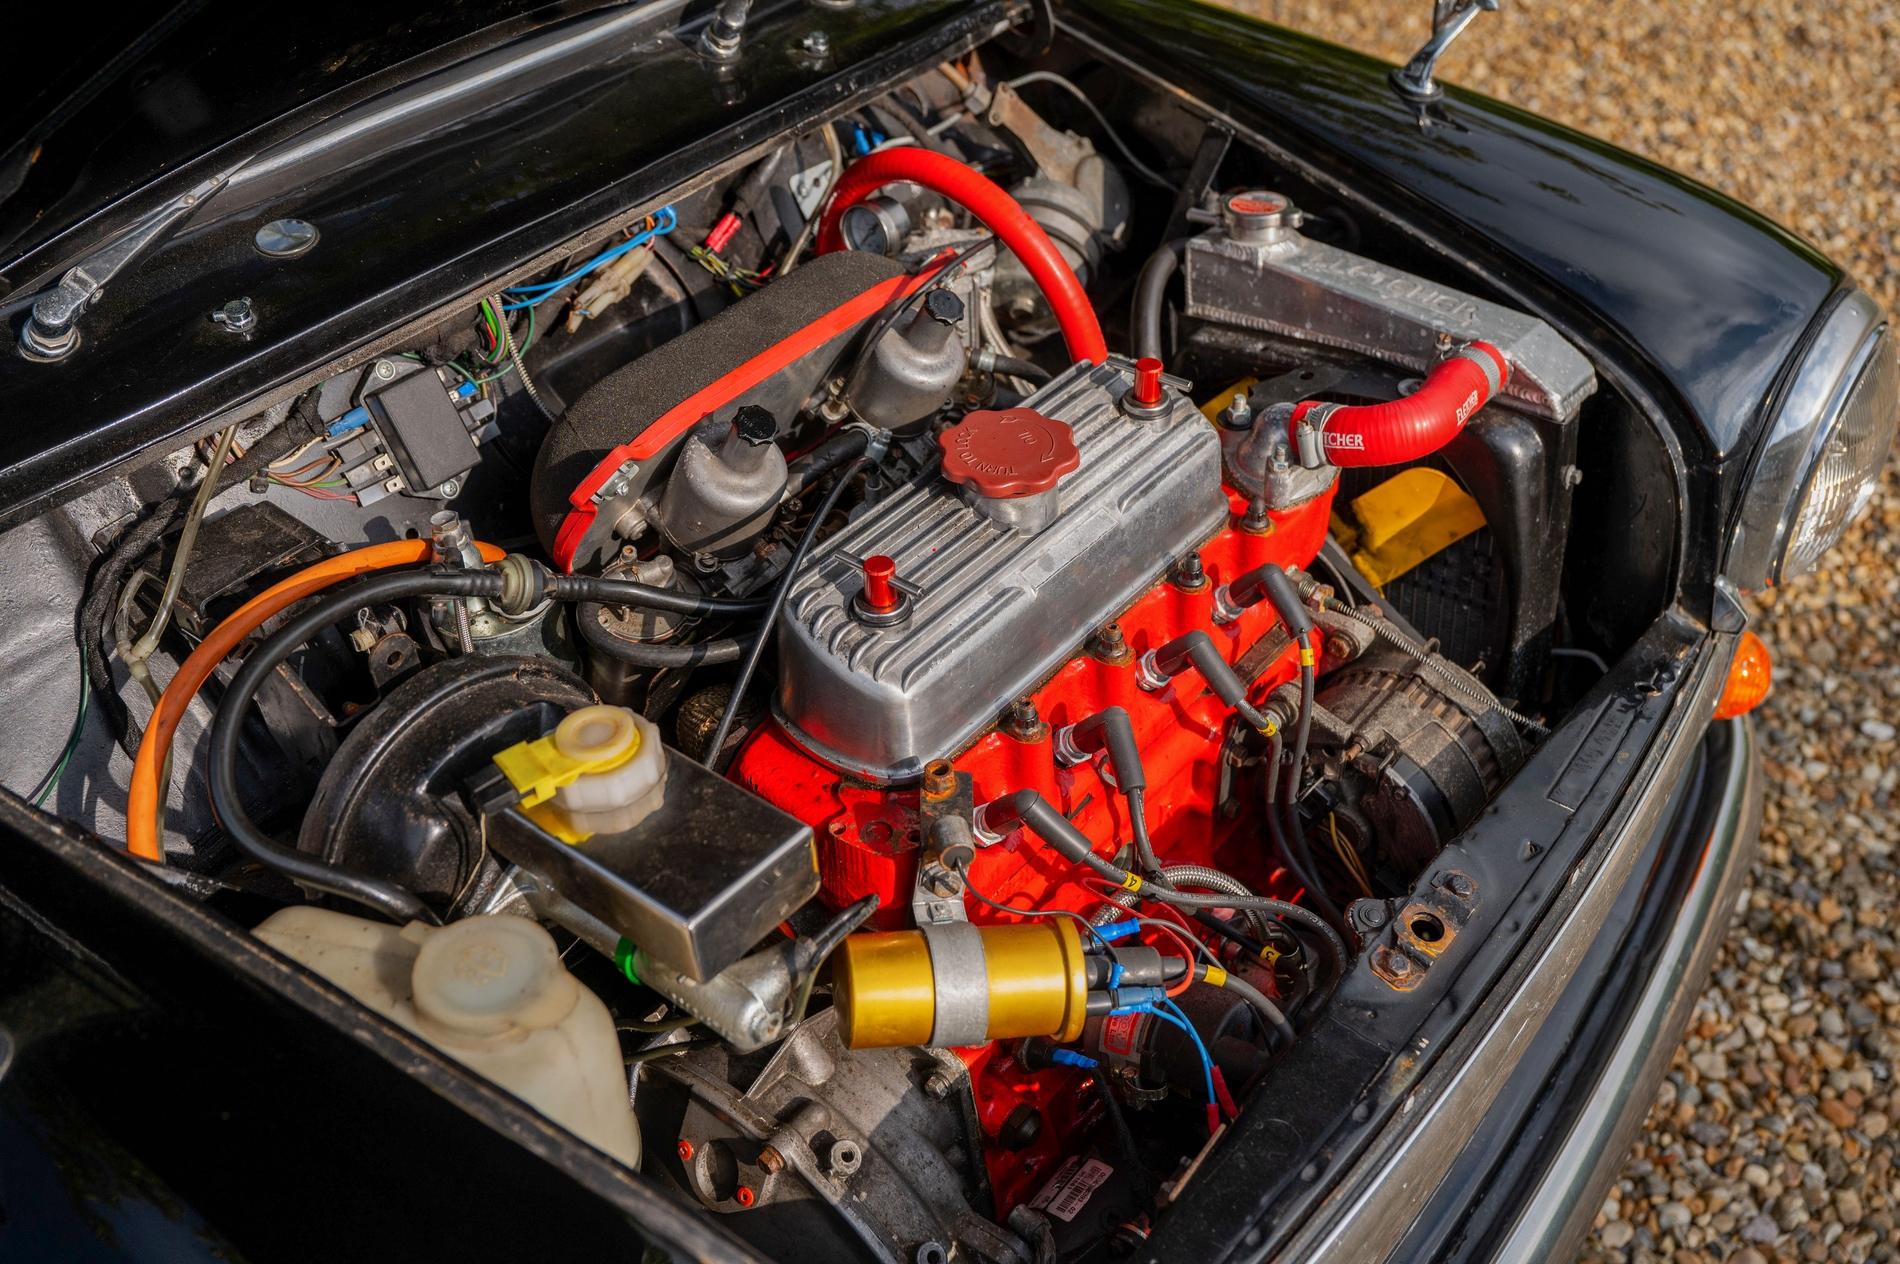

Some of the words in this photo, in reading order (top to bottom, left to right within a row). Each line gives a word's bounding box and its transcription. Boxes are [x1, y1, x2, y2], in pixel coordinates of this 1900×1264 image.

[954, 426, 979, 451] LOCK
[1017, 429, 1038, 446] OIL
[1323, 432, 1364, 448] TCHER
[959, 451, 978, 467] TO
[976, 460, 1018, 477] TURN
